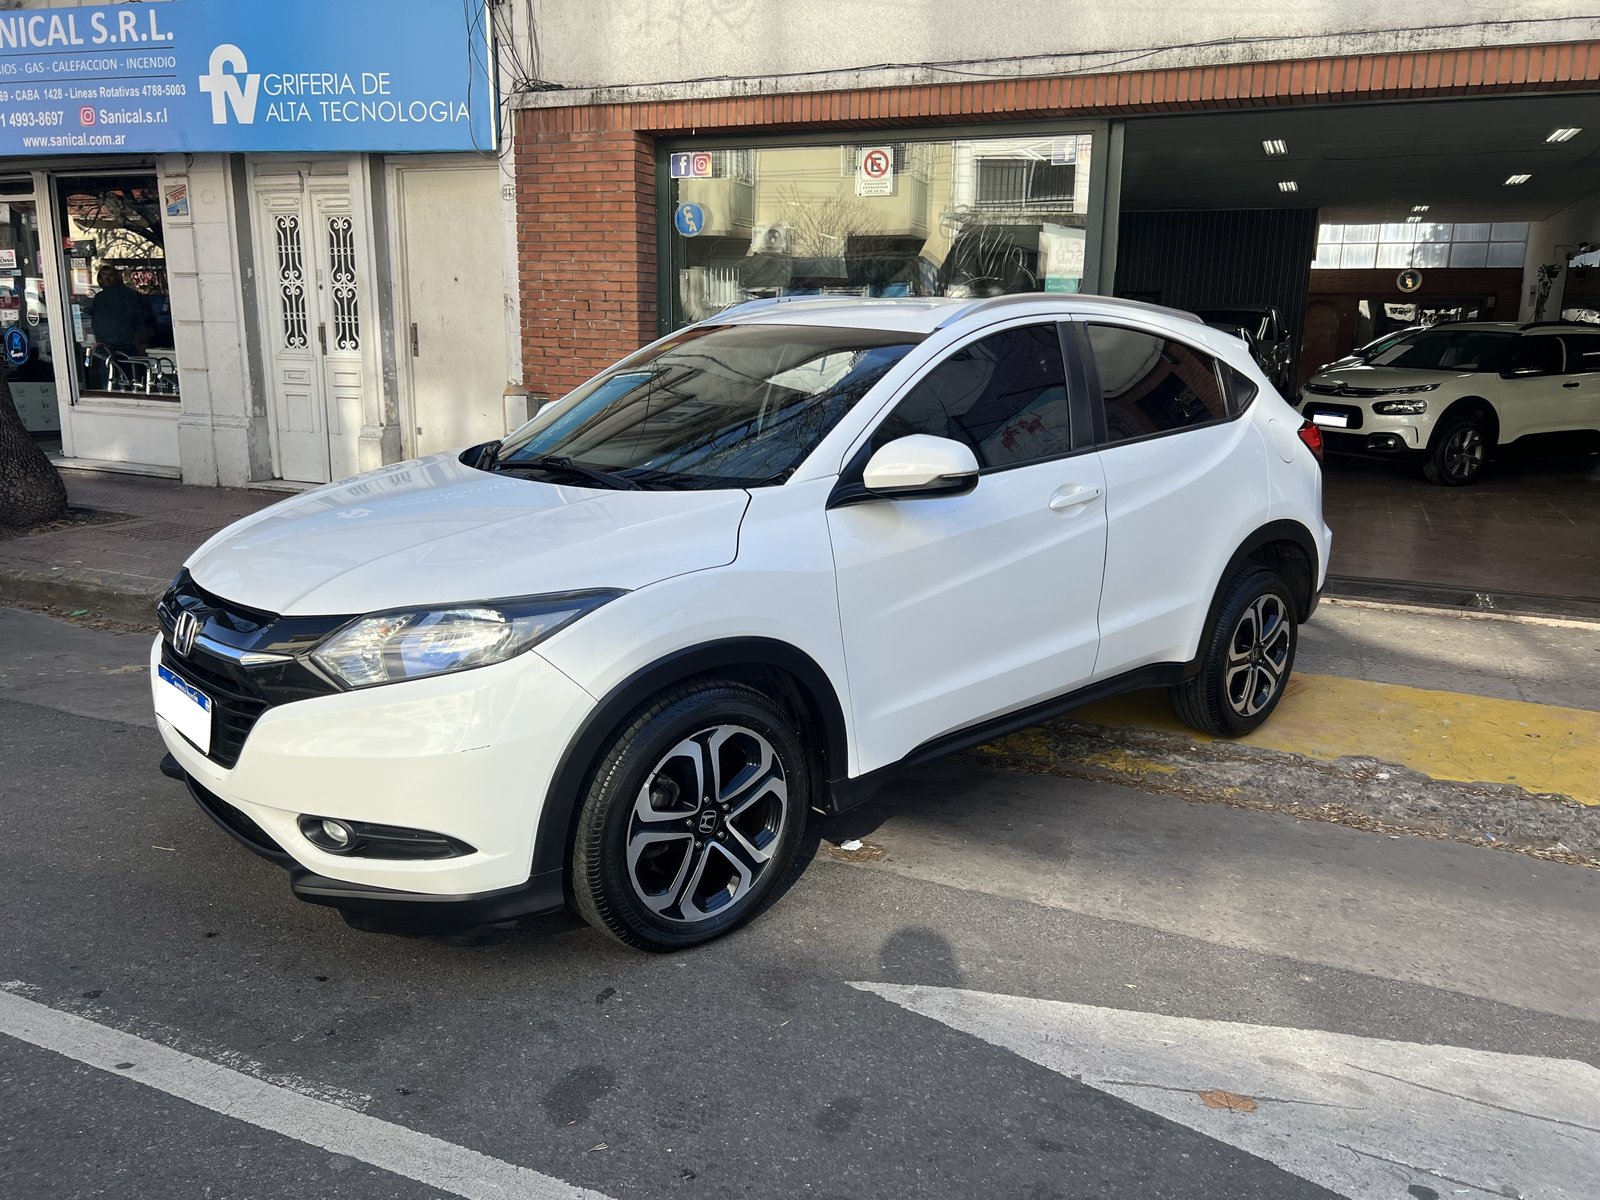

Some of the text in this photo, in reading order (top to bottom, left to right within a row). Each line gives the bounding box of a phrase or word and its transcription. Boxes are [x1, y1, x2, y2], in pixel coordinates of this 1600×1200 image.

[91, 9, 174, 44] S.R.L.
[0, 63, 17, 75] IOS
[25, 62, 44, 74] GAS
[52, 59, 118, 72] CALEFACCION
[126, 56, 176, 69] INCENDIO
[15, 89, 40, 101] CABA
[43, 88, 63, 100] 1428
[99, 86, 140, 98] Rotativas
[142, 84, 186, 97] 4788-5003
[263, 72, 391, 96] GRIFERIA DE
[9, 110, 64, 127] 4993-8697
[100, 108, 168, 124] Sanical.s.r.l
[265, 100, 470, 123] ALTA TECNOLOGIA
[23, 132, 126, 147] www.sanical.com.ar
